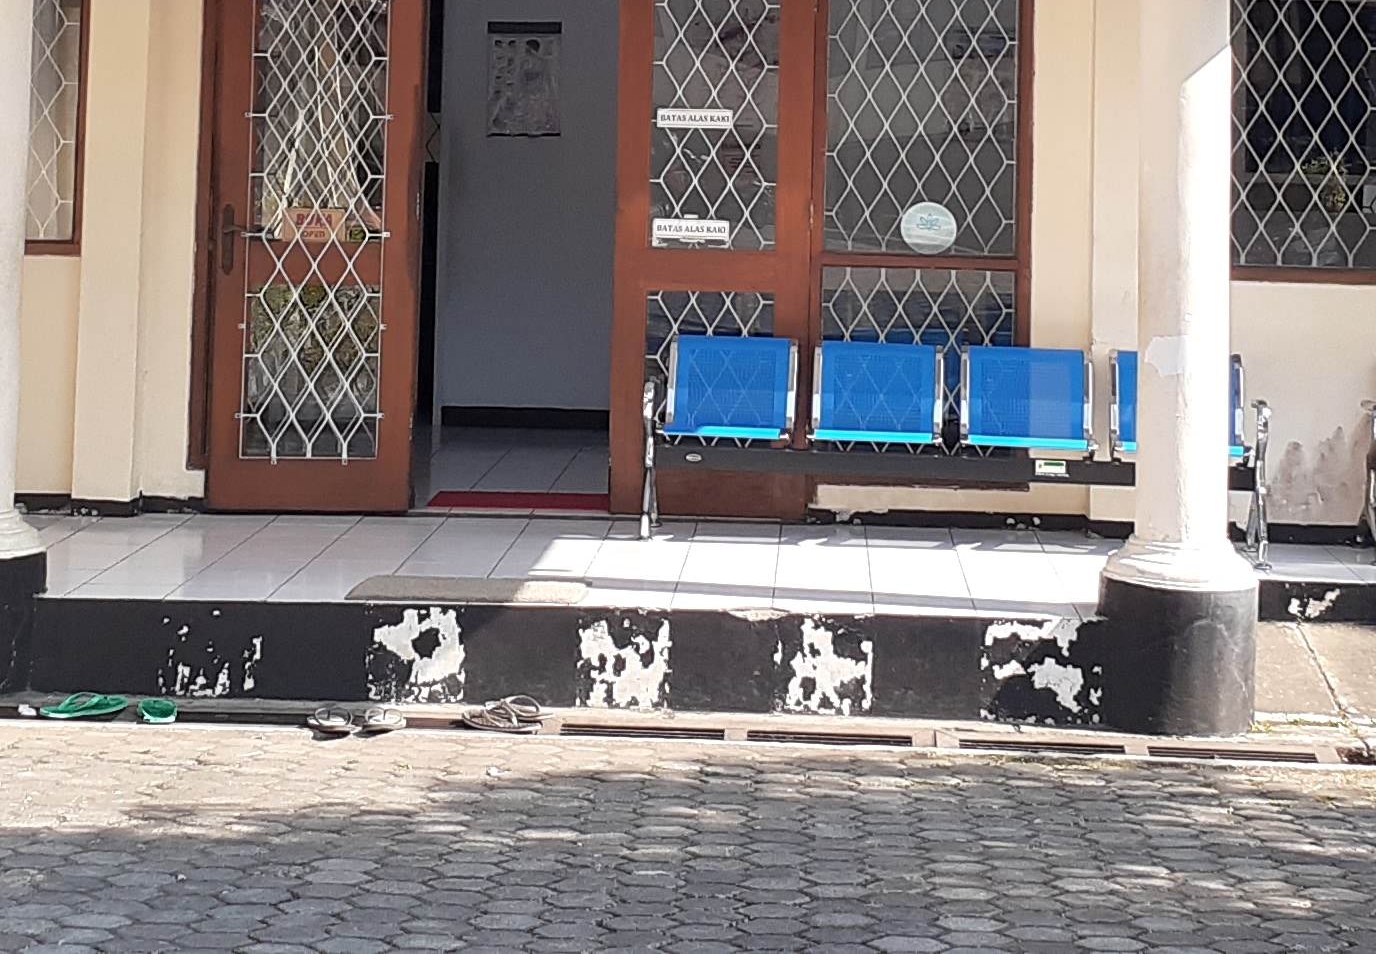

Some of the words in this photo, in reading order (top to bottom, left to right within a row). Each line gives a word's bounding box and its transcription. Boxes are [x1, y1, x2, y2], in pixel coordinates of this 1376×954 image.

[660, 114, 686, 122] BATAS
[688, 114, 708, 122] ALAS
[710, 115, 730, 123] KAKI
[657, 224, 683, 233] BATAS
[684, 225, 704, 233] ALAS
[706, 226, 726, 234] KAKI
